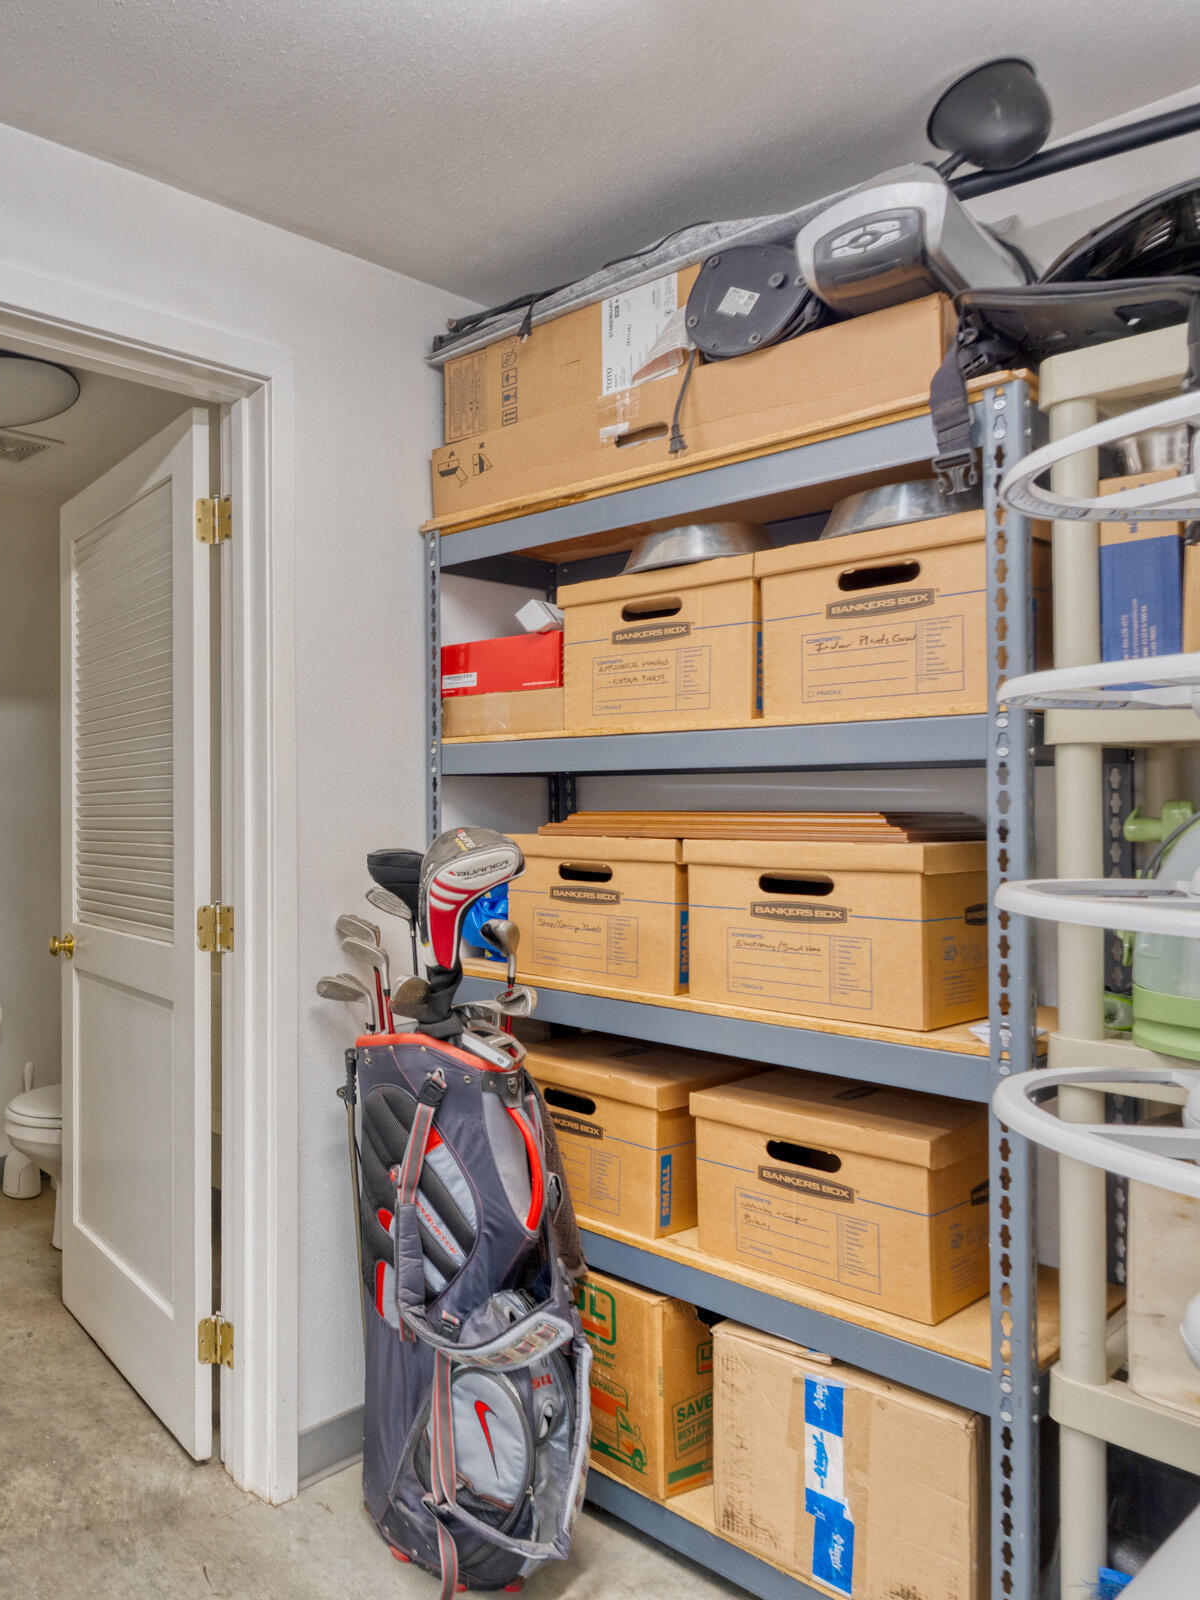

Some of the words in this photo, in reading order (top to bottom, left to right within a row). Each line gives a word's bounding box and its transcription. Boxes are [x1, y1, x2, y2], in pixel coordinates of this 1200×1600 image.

[831, 597, 896, 615] BANKERS
[897, 592, 930, 606] BOX
[614, 627, 662, 643] BANKERS
[662, 624, 687, 638] BOX
[553, 888, 596, 900] BANKERS
[596, 892, 618, 902] BOX
[754, 905, 814, 918] BANKERS
[814, 908, 843, 920] BOX
[580, 1123, 601, 1137] BOX
[761, 1168, 821, 1191] BANKERS
[821, 1183, 851, 1200] BOX
